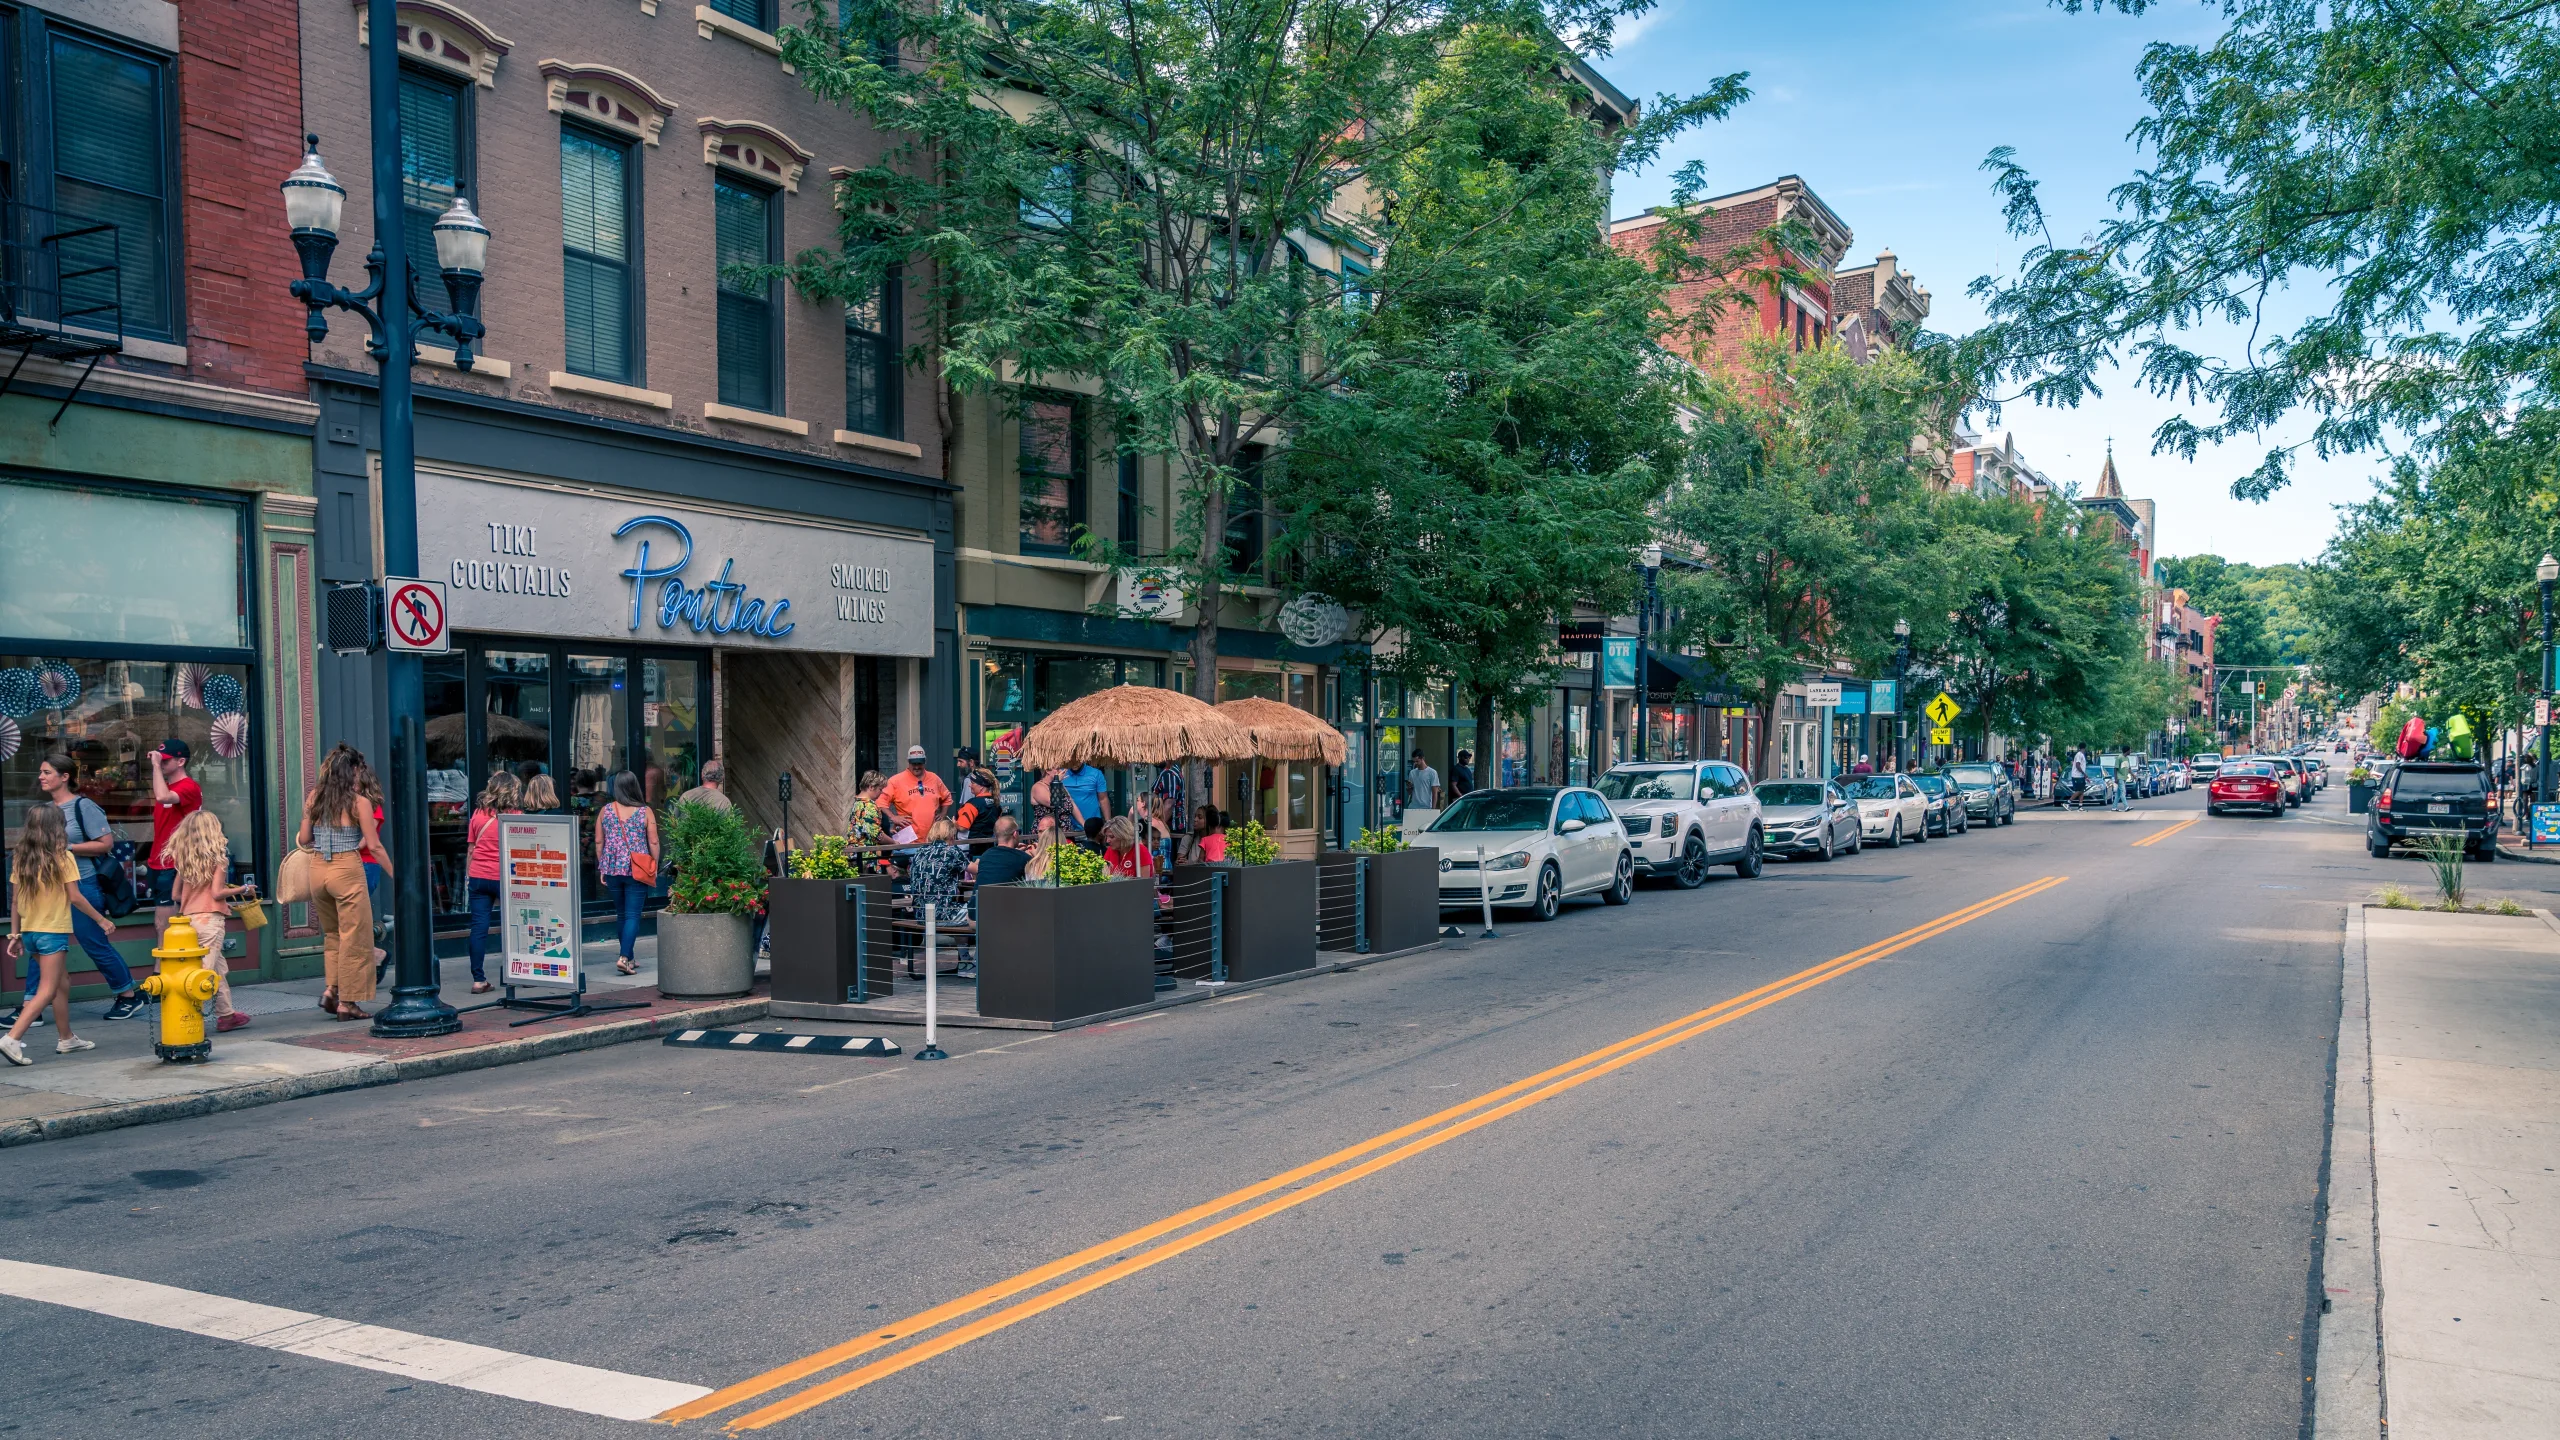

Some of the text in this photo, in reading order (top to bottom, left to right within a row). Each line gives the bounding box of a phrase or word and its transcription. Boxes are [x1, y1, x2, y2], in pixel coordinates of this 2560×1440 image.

[488, 522, 537, 557] TIKI
[451, 558, 571, 597] COCKTAILS
[611, 515, 795, 638] Pontiac
[831, 563, 890, 593] SMOKED
[837, 595, 886, 623] WINGS
[1132, 601, 1168, 614] BOOORE
[1609, 646, 1630, 656] OTR
[908, 787, 935, 796] BENALS
[1403, 828, 1420, 836] Cont
[511, 961, 523, 974] OTR
